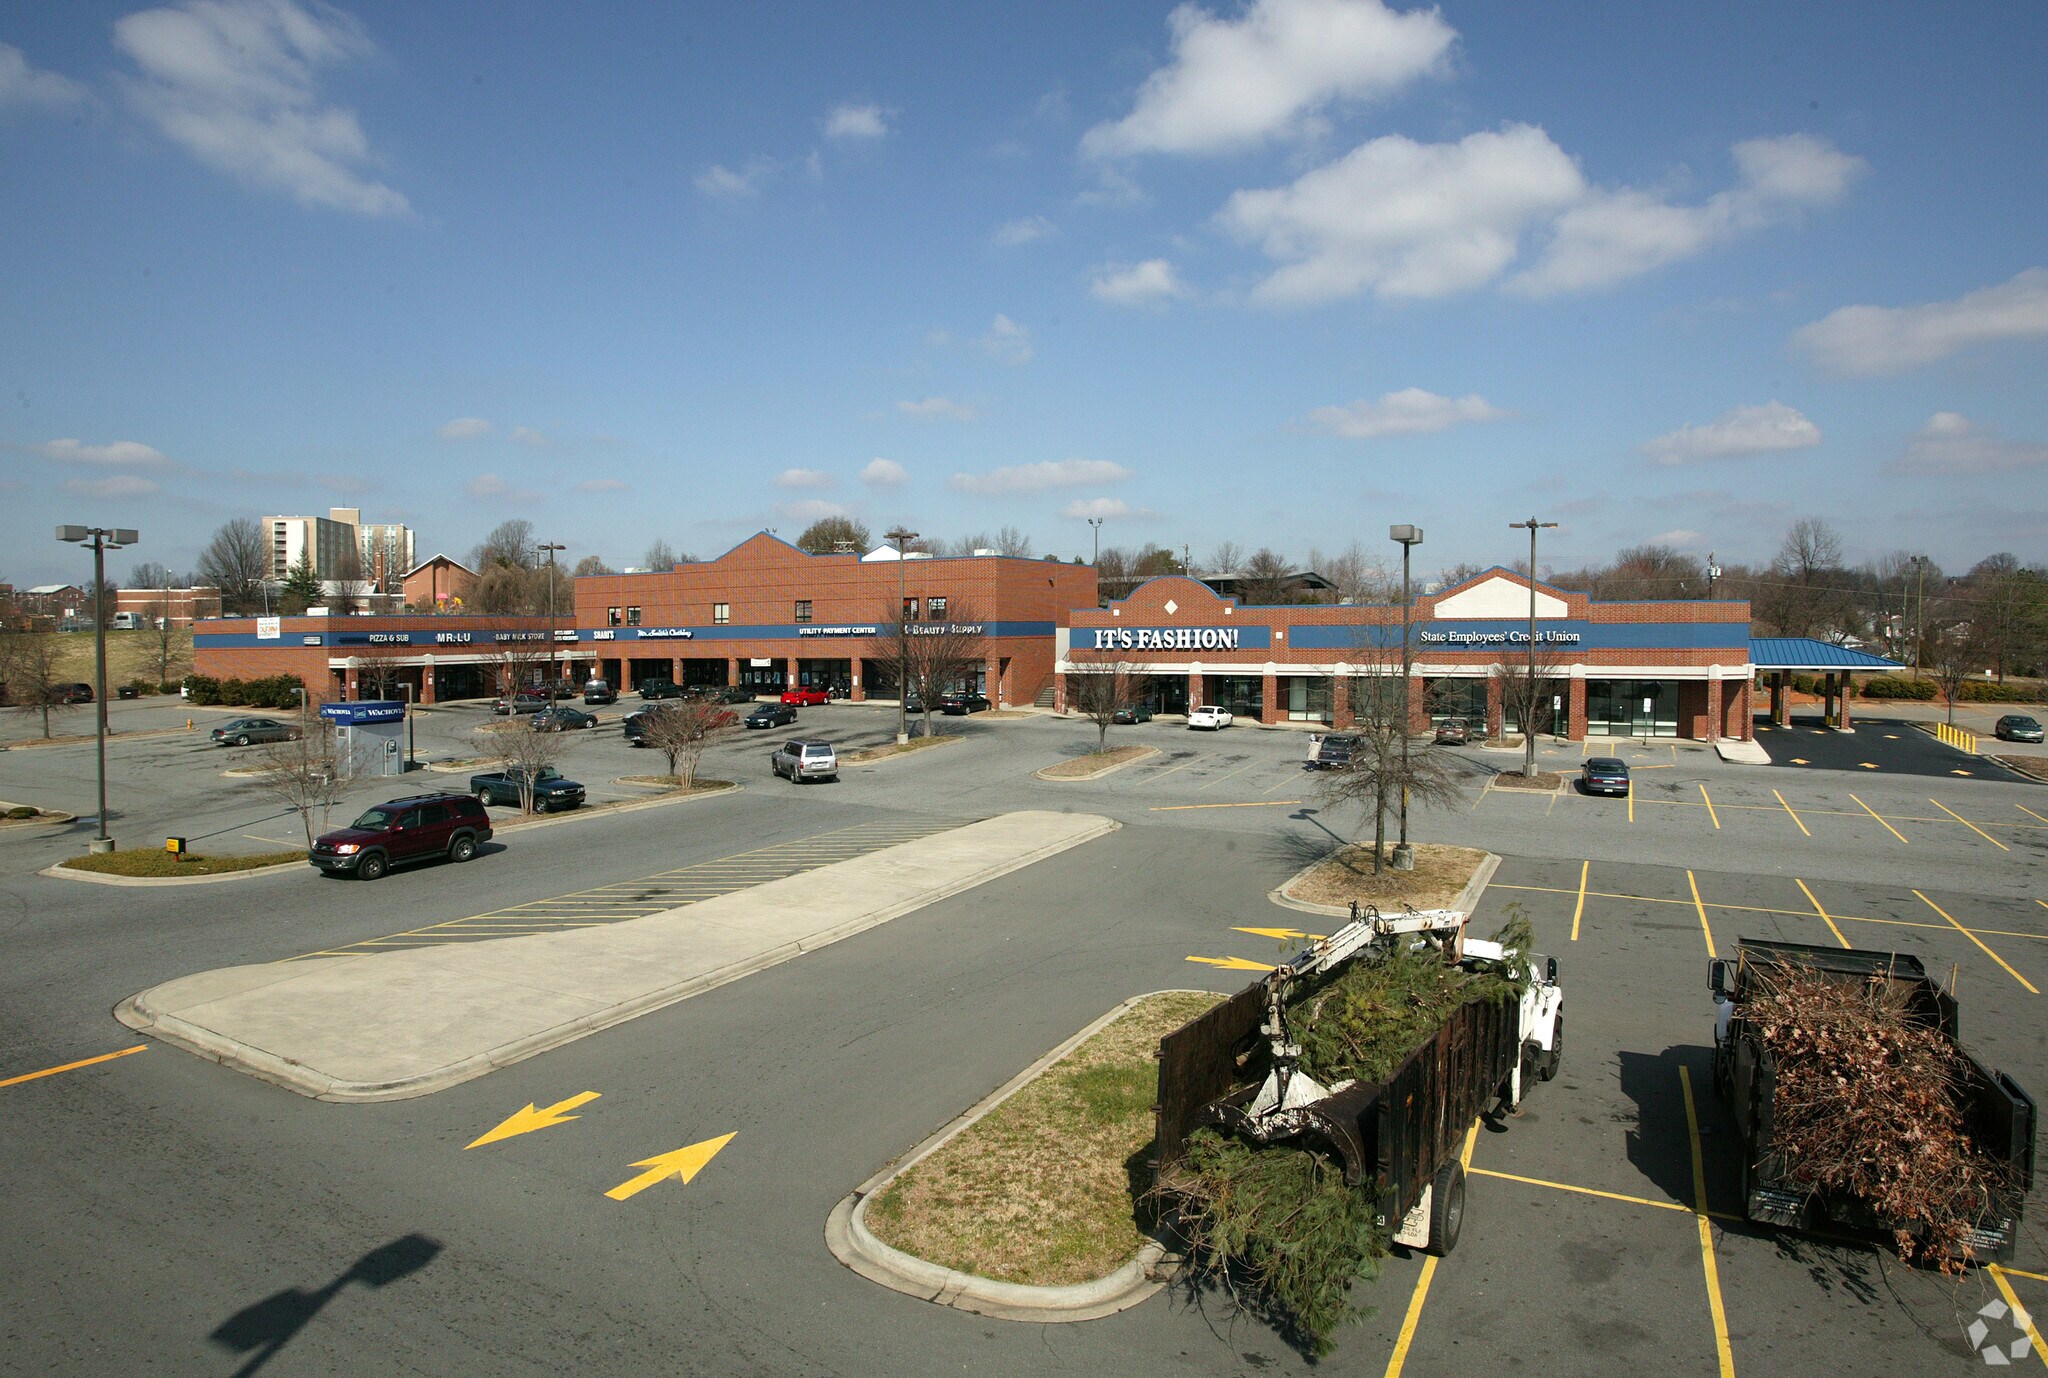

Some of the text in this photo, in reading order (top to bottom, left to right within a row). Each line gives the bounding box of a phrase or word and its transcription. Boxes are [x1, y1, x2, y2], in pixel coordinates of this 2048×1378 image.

[369, 634, 410, 642] PIZZA & SUB
[437, 633, 471, 642] MR. LU
[1095, 627, 1239, 649] IT'S FASHION!
[1420, 631, 1580, 644] State Employees' Creit Union
[367, 708, 404, 716] WACHOVIA
